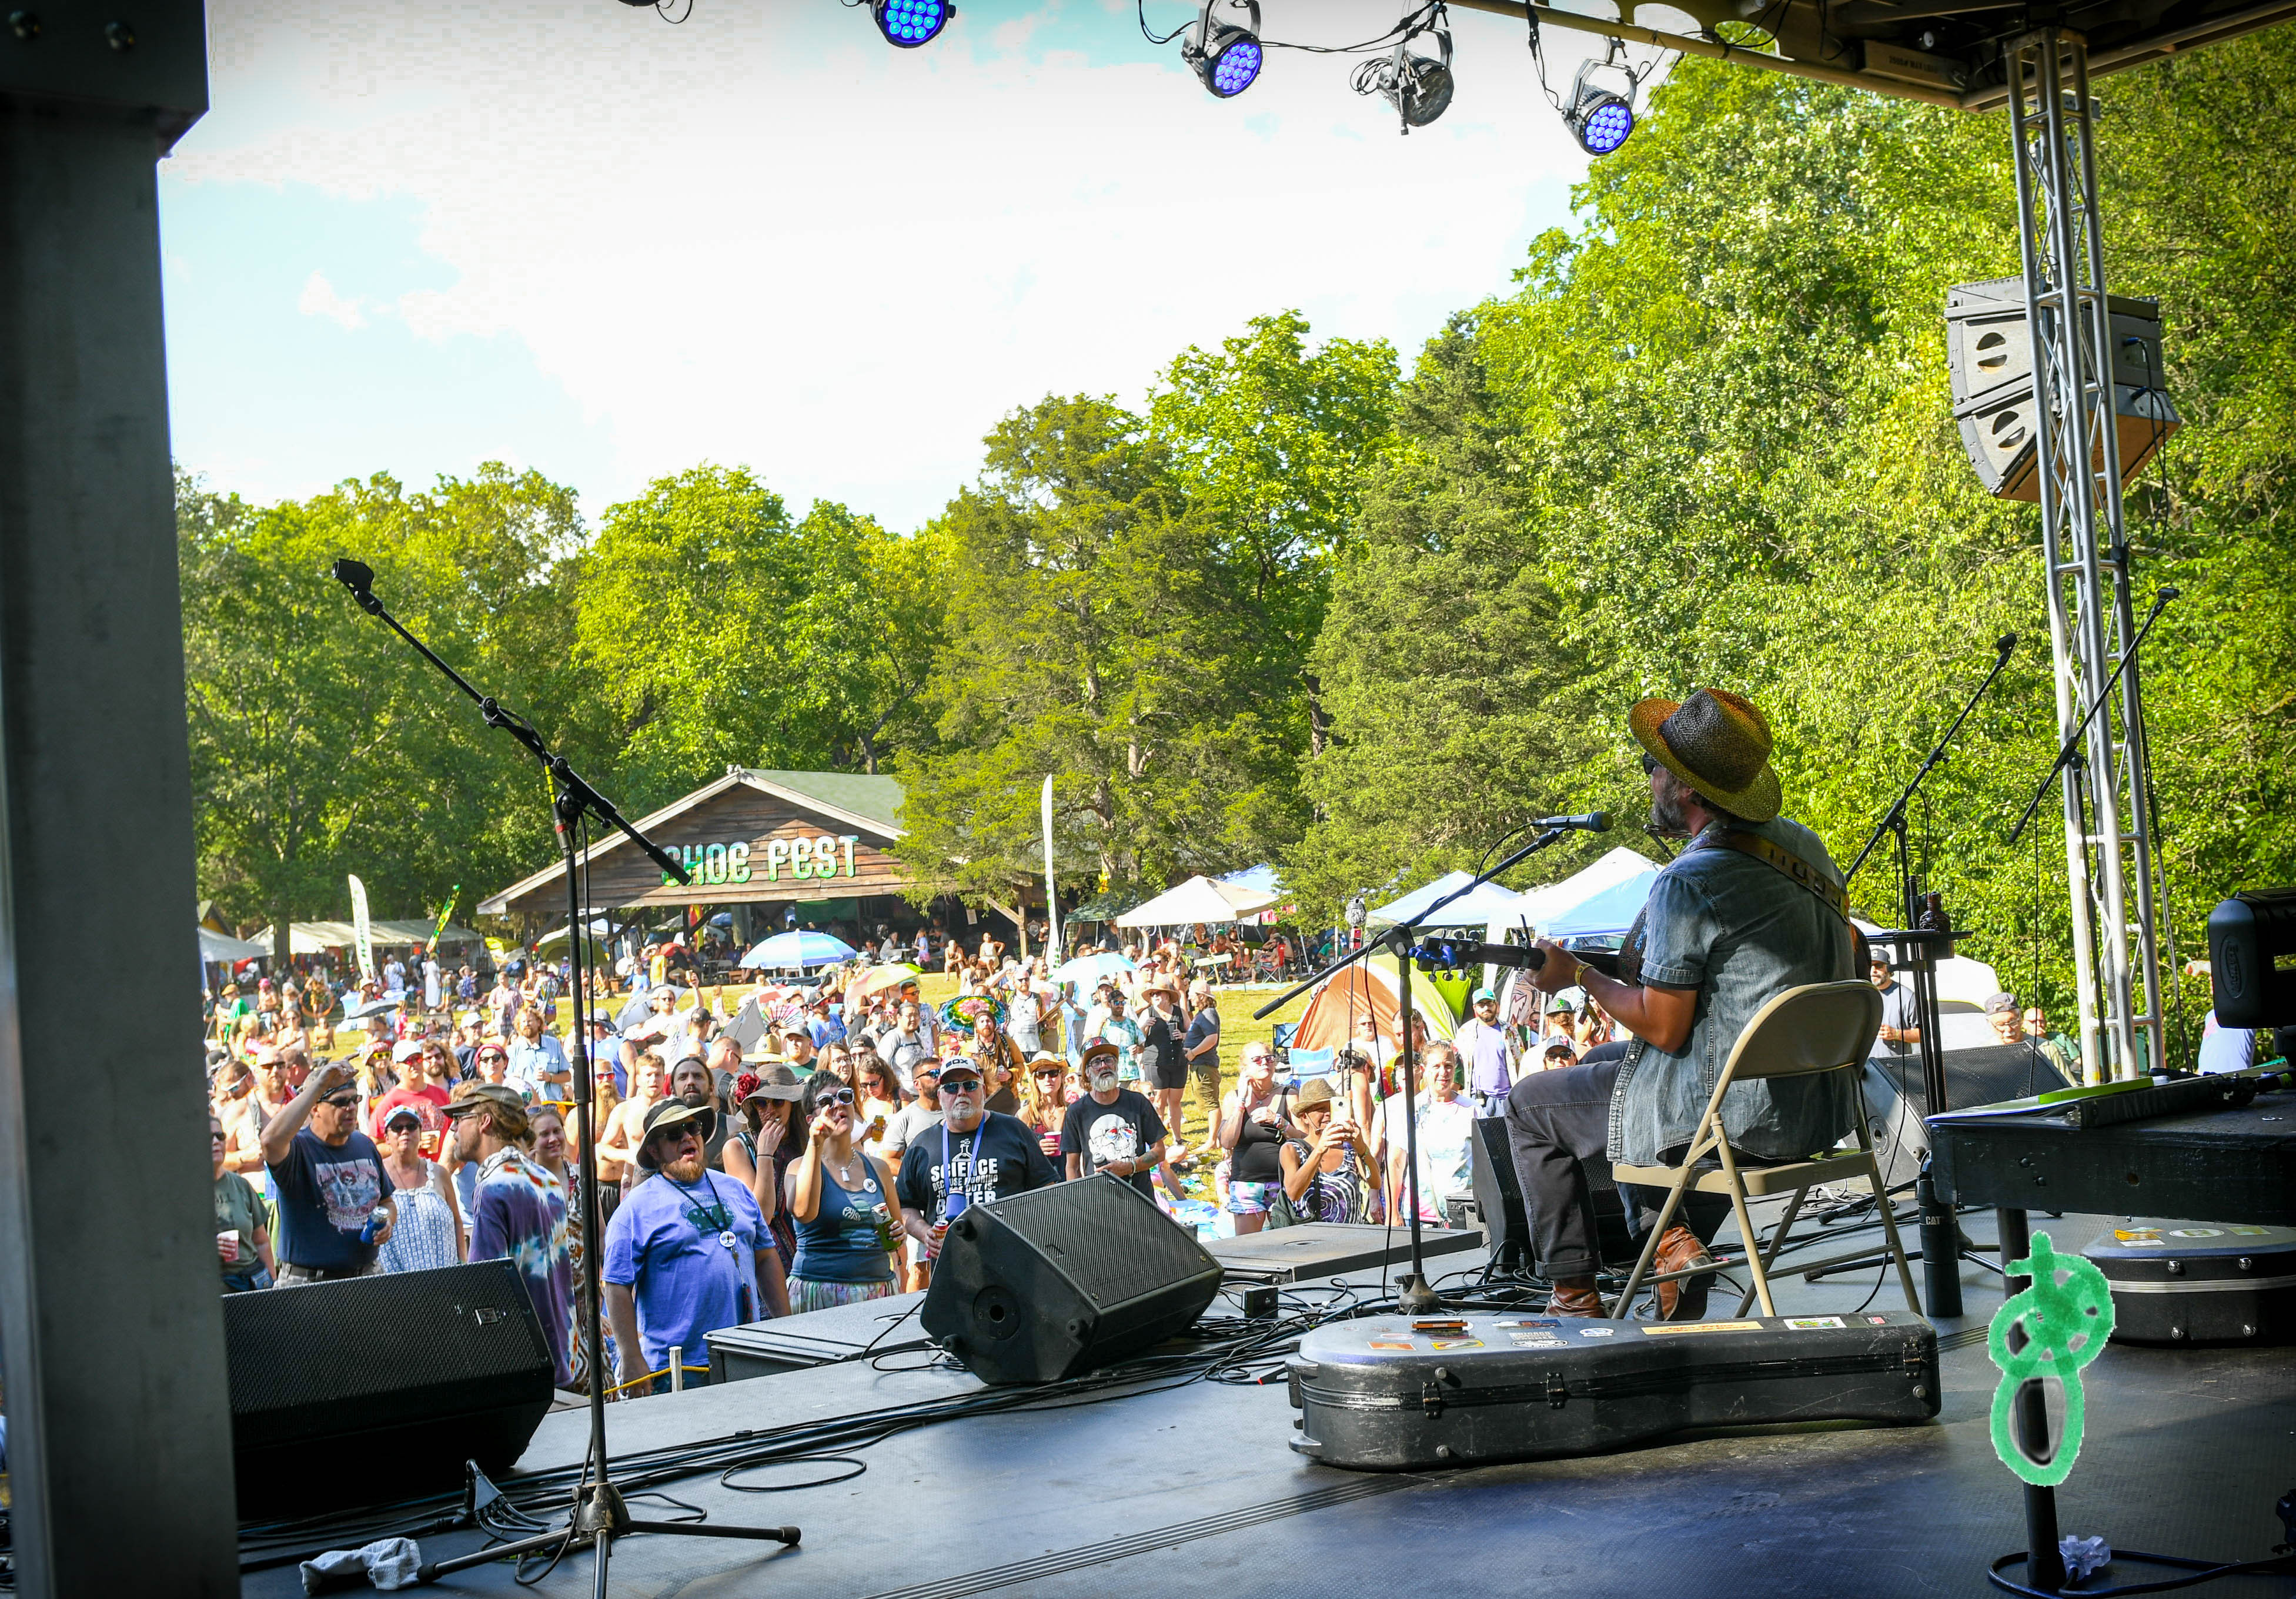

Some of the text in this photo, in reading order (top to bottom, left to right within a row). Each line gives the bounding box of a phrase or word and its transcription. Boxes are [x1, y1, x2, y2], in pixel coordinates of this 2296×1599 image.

[661, 835, 859, 887] SHOE FEST
[930, 1158, 998, 1182] SCIENCE
[932, 1177, 962, 1192] BECUSE
[965, 1183, 982, 1193] OUT
[936, 1190, 997, 1215] BTER
[1926, 1216, 1942, 1225] CAT
